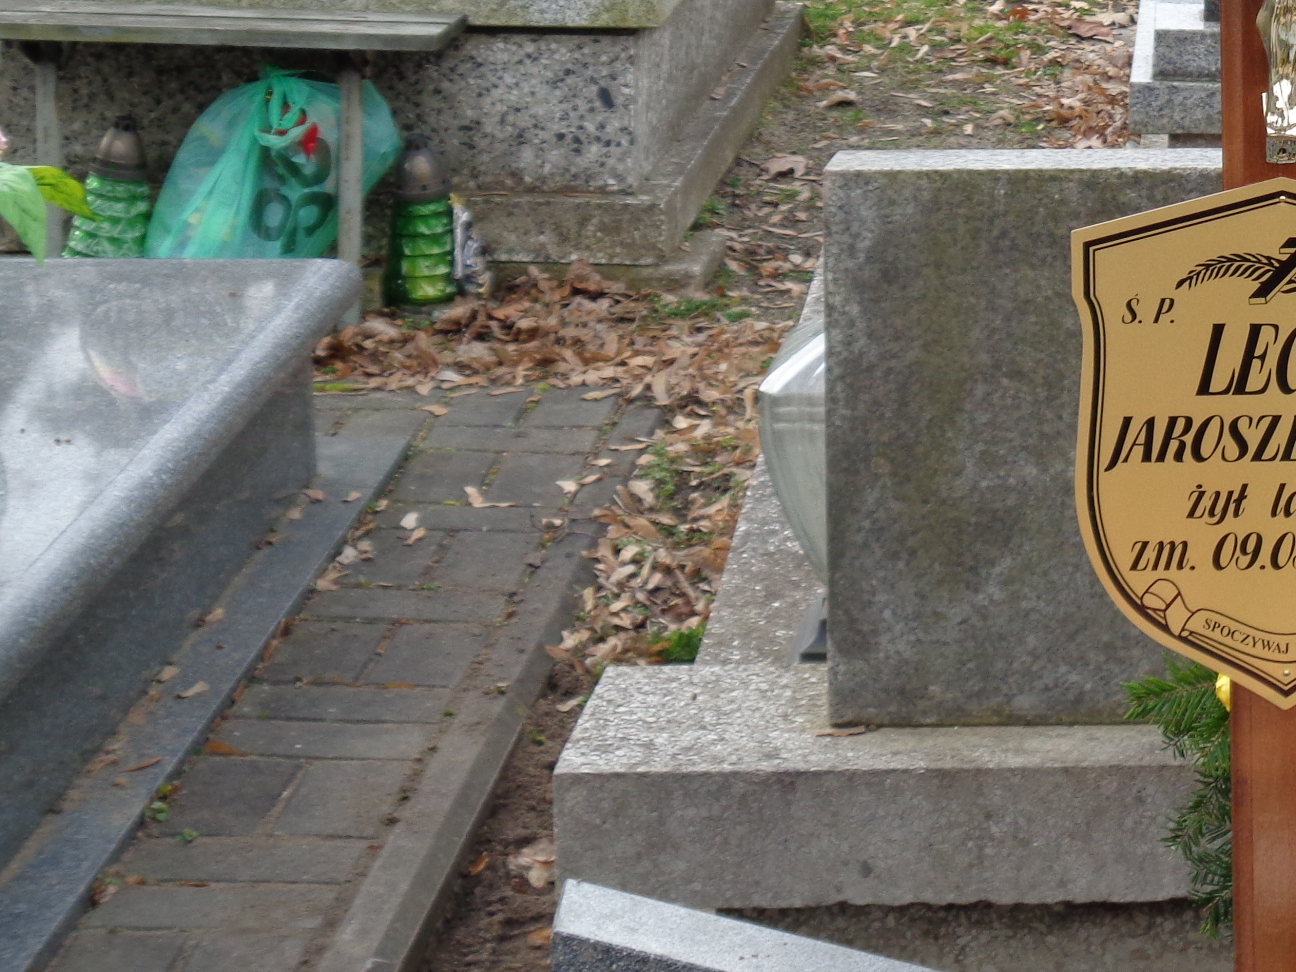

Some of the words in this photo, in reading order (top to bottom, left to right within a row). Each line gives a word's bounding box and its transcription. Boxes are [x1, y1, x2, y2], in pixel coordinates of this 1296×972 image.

[1121, 293, 1143, 325] Ś.
[1152, 297, 1175, 324] P.
[1185, 482, 1249, 526] żył
[1129, 540, 1196, 572] zm.
[1202, 617, 1290, 655] SPOCZYWAJ
